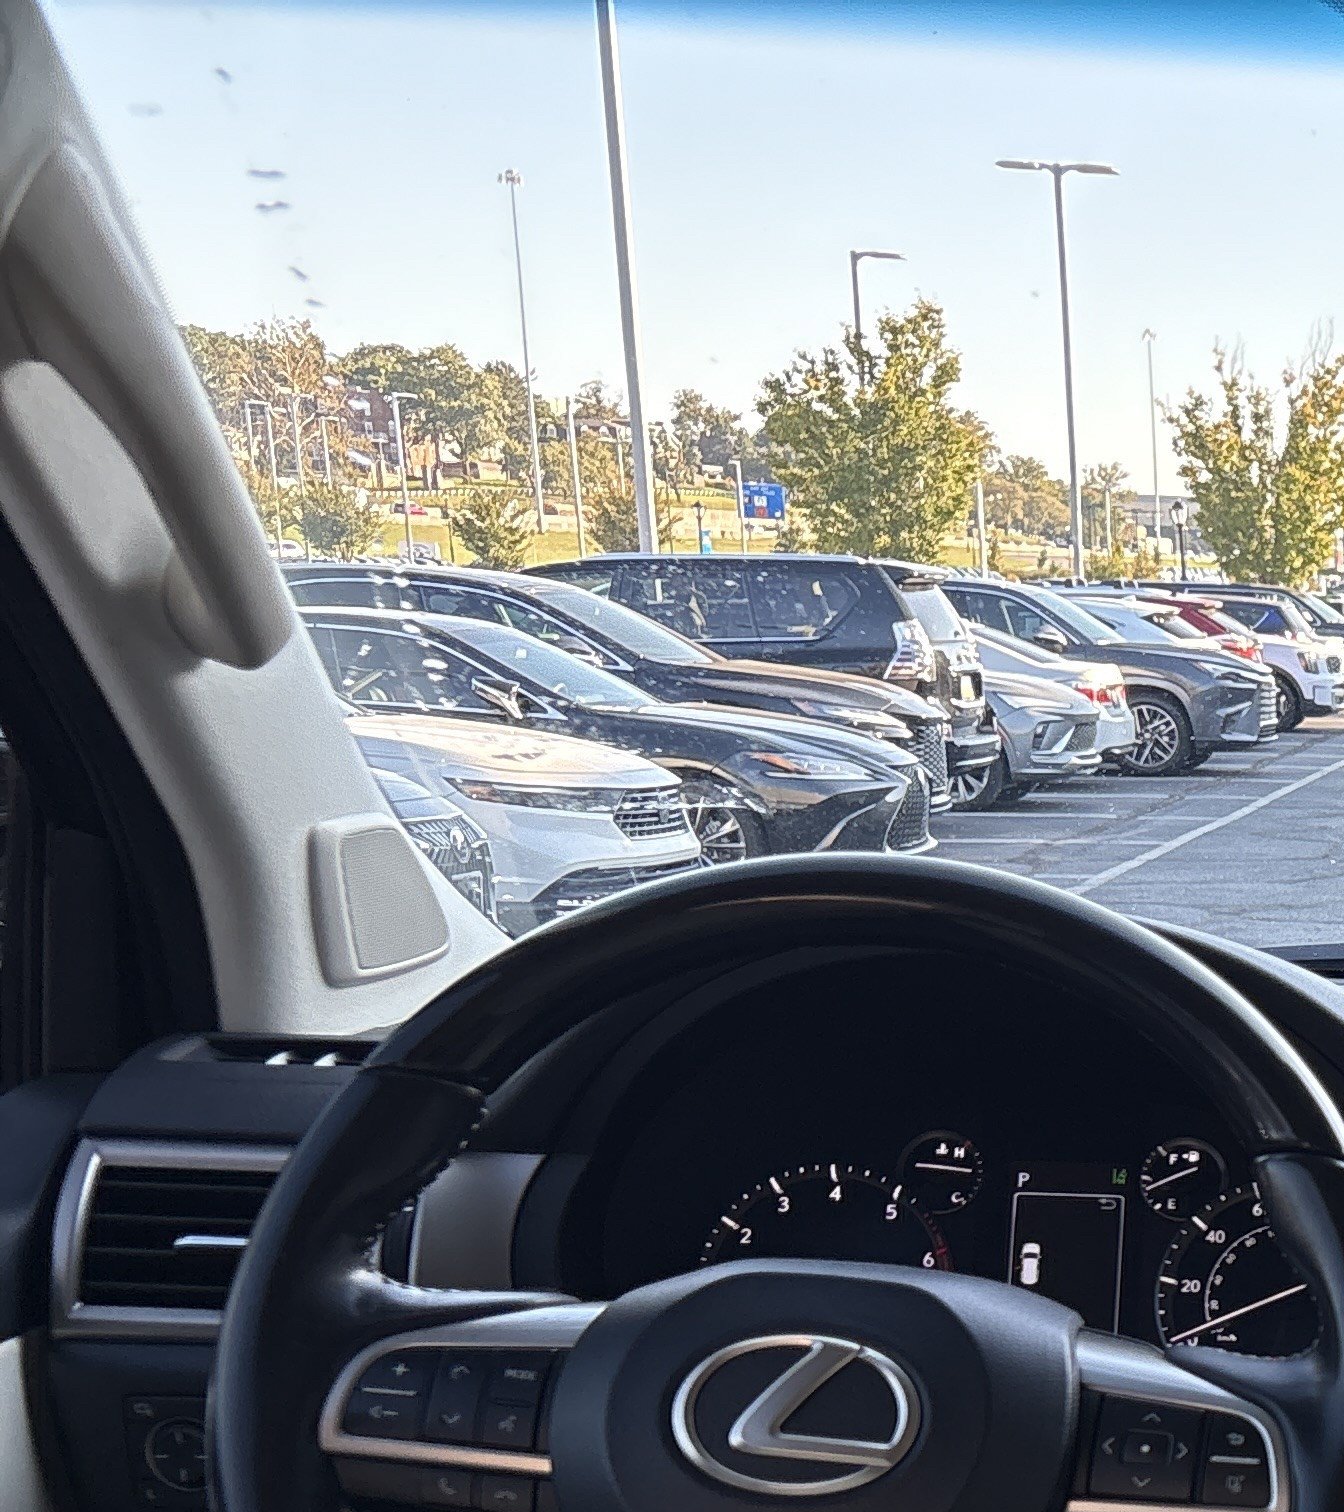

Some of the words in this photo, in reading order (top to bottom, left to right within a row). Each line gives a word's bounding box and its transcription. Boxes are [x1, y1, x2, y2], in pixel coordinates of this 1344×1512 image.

[954, 1147, 965, 1158] H
[1169, 1154, 1179, 1165] F
[1018, 1172, 1030, 1187] P
[828, 1186, 841, 1201] 4
[777, 1197, 790, 1213] 3
[1167, 1198, 1177, 1209] E
[1252, 1203, 1263, 1217] 6
[885, 1204, 897, 1220] 5
[739, 1228, 752, 1244] 2
[1206, 1230, 1226, 1244] 40
[922, 1252, 935, 1268] 6
[1181, 1279, 1201, 1294] 20
